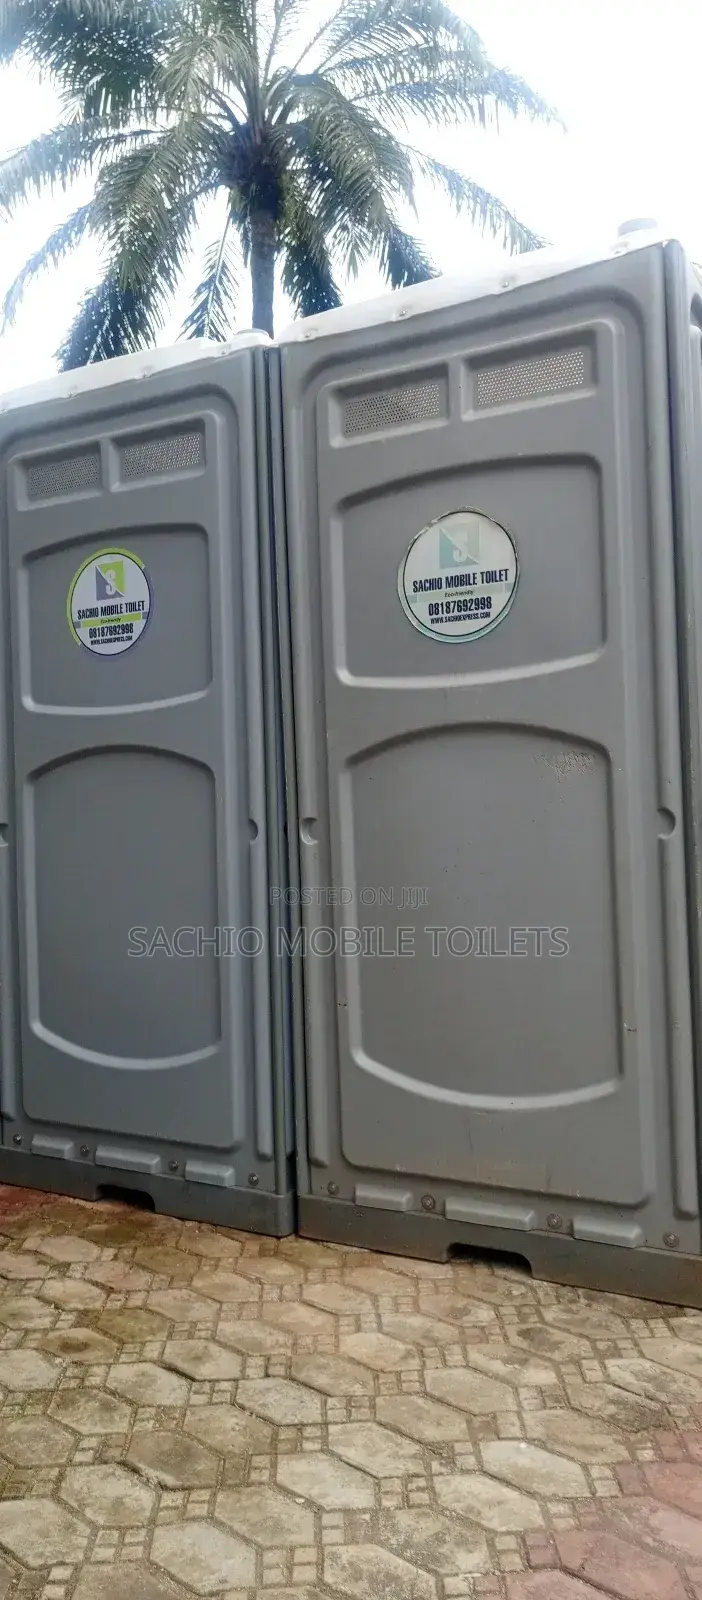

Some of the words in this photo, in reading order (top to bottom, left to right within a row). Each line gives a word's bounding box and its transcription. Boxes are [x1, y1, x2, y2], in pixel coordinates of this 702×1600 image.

[105, 569, 116, 595] S
[412, 577, 443, 593] SACHIO
[445, 572, 478, 589] MOBILE
[480, 568, 509, 584] TOILET
[77, 607, 99, 620] SACHIO
[100, 603, 123, 617] MOBILE
[125, 600, 145, 612] TOILET
[428, 596, 492, 616] 08187692998
[88, 623, 134, 639] 08187692998
